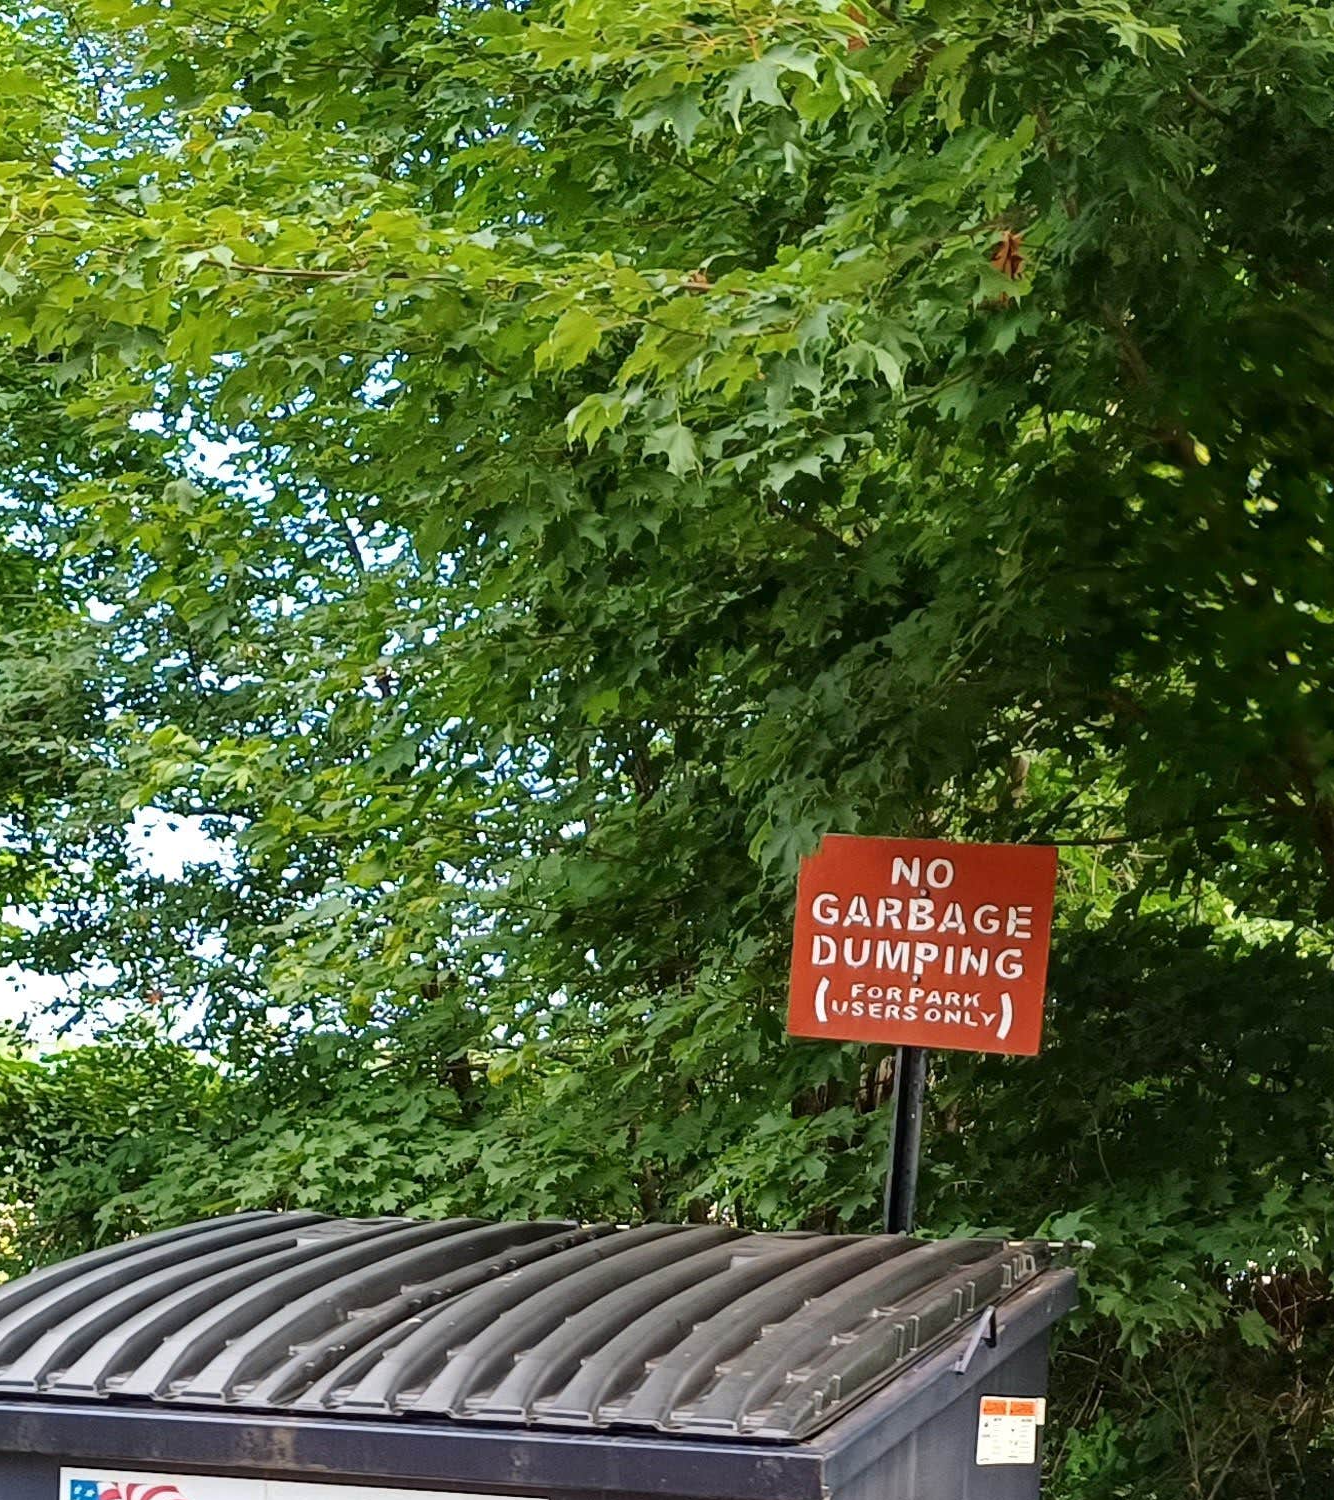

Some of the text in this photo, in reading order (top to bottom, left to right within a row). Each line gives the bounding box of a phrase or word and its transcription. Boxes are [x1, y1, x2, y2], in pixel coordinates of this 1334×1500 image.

[891, 857, 954, 888] NO
[812, 893, 1033, 939] GARBAGE
[811, 935, 1025, 980] DUMPING
[909, 987, 981, 1008] PARK
